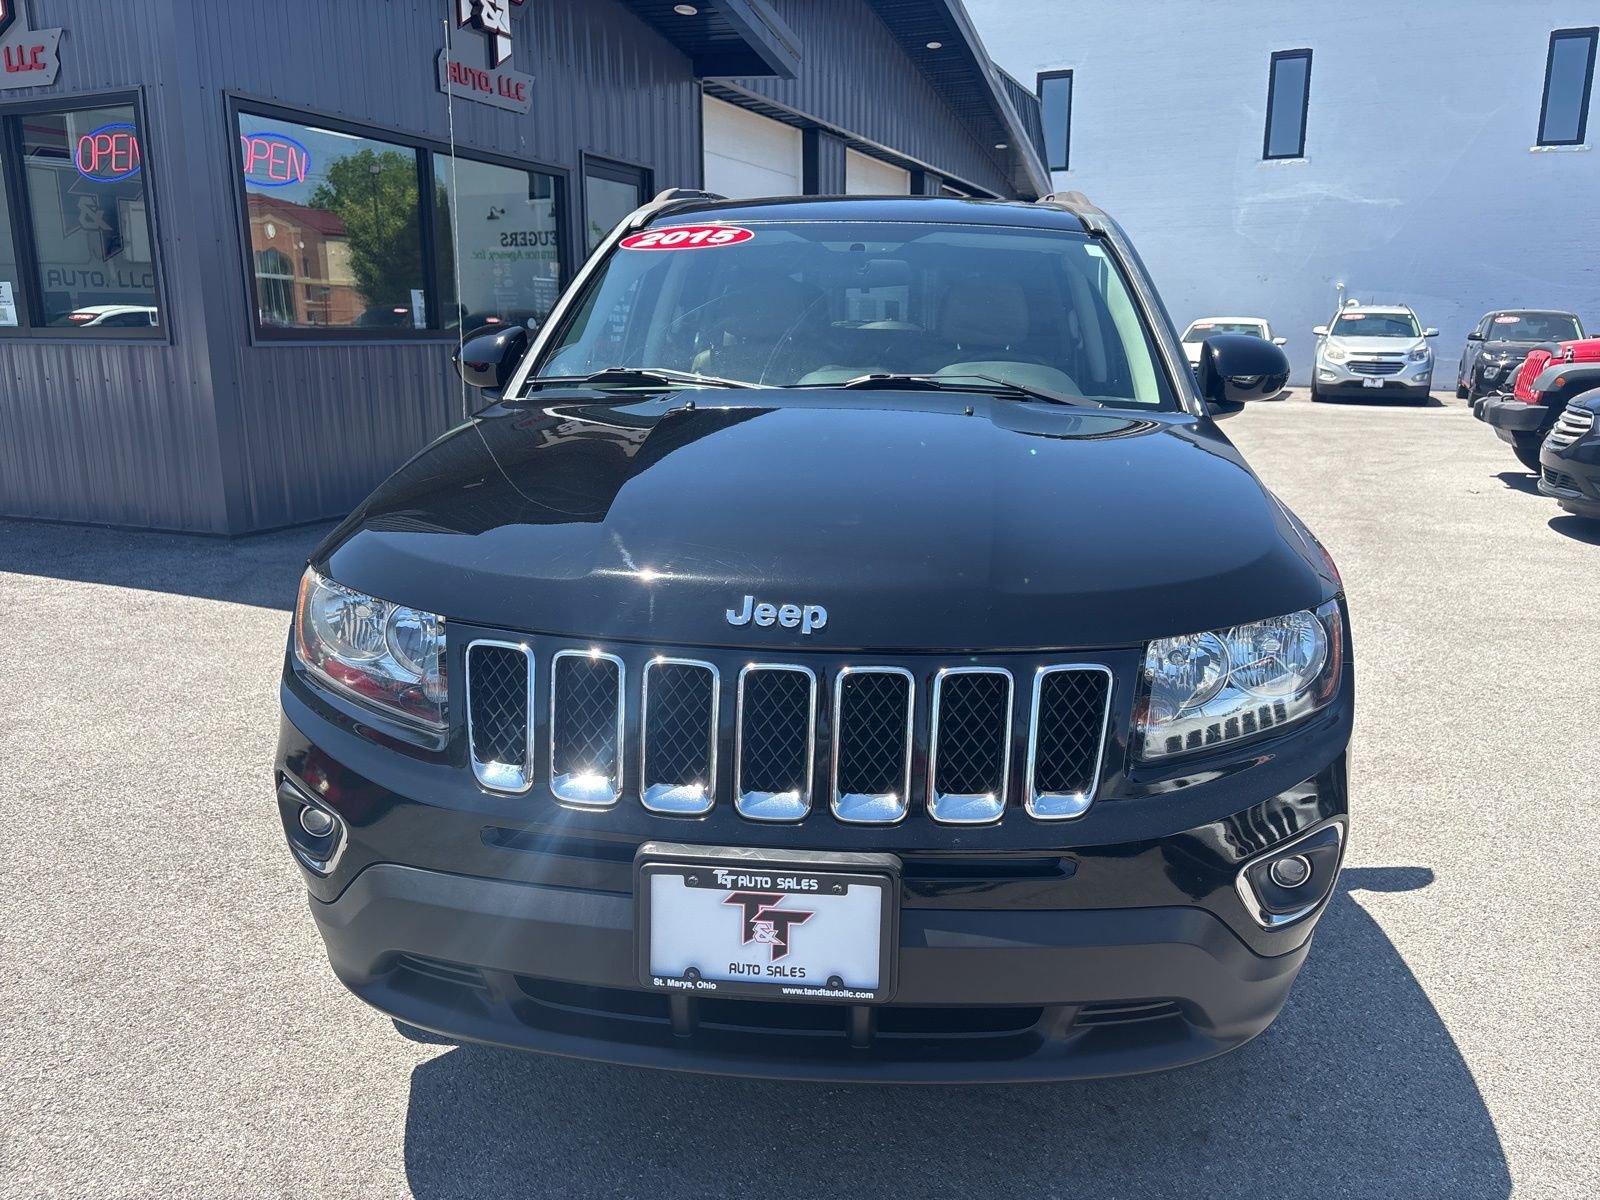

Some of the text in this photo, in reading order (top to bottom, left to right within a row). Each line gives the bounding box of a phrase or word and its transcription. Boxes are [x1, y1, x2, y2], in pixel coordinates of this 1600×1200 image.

[4, 45, 47, 73] LLC
[446, 61, 527, 102] AUTO, LLC
[630, 229, 742, 248] 2015
[117, 269, 154, 289] LLC
[726, 595, 828, 634] Jeep
[738, 875, 771, 889] AUTO
[777, 876, 819, 890] SALES
[728, 962, 806, 978] AUTO SALES
[653, 977, 717, 990] St. Marys, Ohio
[782, 987, 874, 999] www.tandtautollc.com
